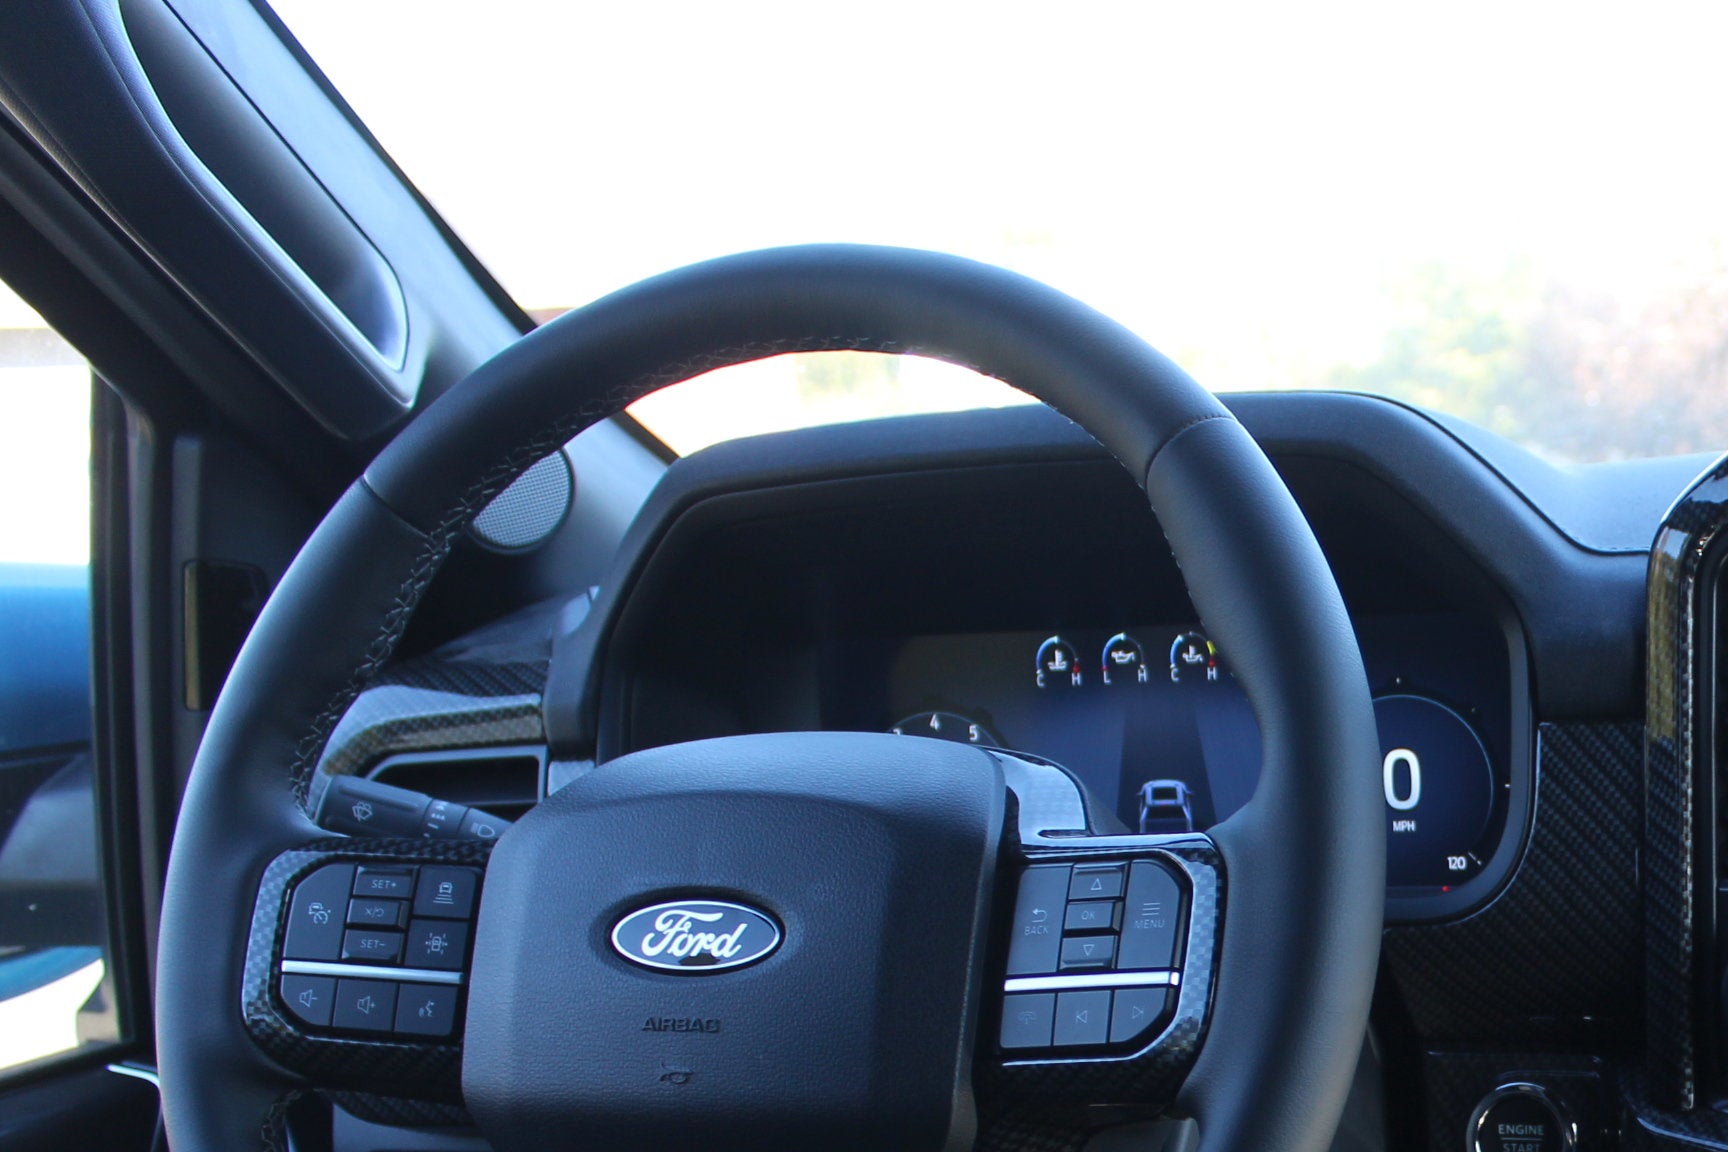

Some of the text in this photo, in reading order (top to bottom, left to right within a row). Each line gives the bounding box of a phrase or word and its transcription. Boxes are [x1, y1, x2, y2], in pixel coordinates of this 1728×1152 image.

[1071, 673, 1082, 686] H
[1103, 671, 1112, 685] L
[1138, 669, 1148, 682] H
[1170, 669, 1180, 683] C
[1207, 667, 1218, 680] H
[1036, 674, 1045, 688] C
[929, 713, 940, 731] 4
[968, 724, 980, 741] 5
[1383, 748, 1421, 811] 0
[1392, 820, 1416, 832] MPH
[1447, 855, 1467, 870] 120
[371, 879, 397, 890] SET+
[1081, 910, 1096, 921] OK
[1024, 925, 1049, 937] BACK
[1134, 919, 1166, 930] MENU
[641, 909, 749, 959] Ford
[642, 1016, 722, 1033] AIRBAG
[1498, 1123, 1545, 1136] ENGINE
